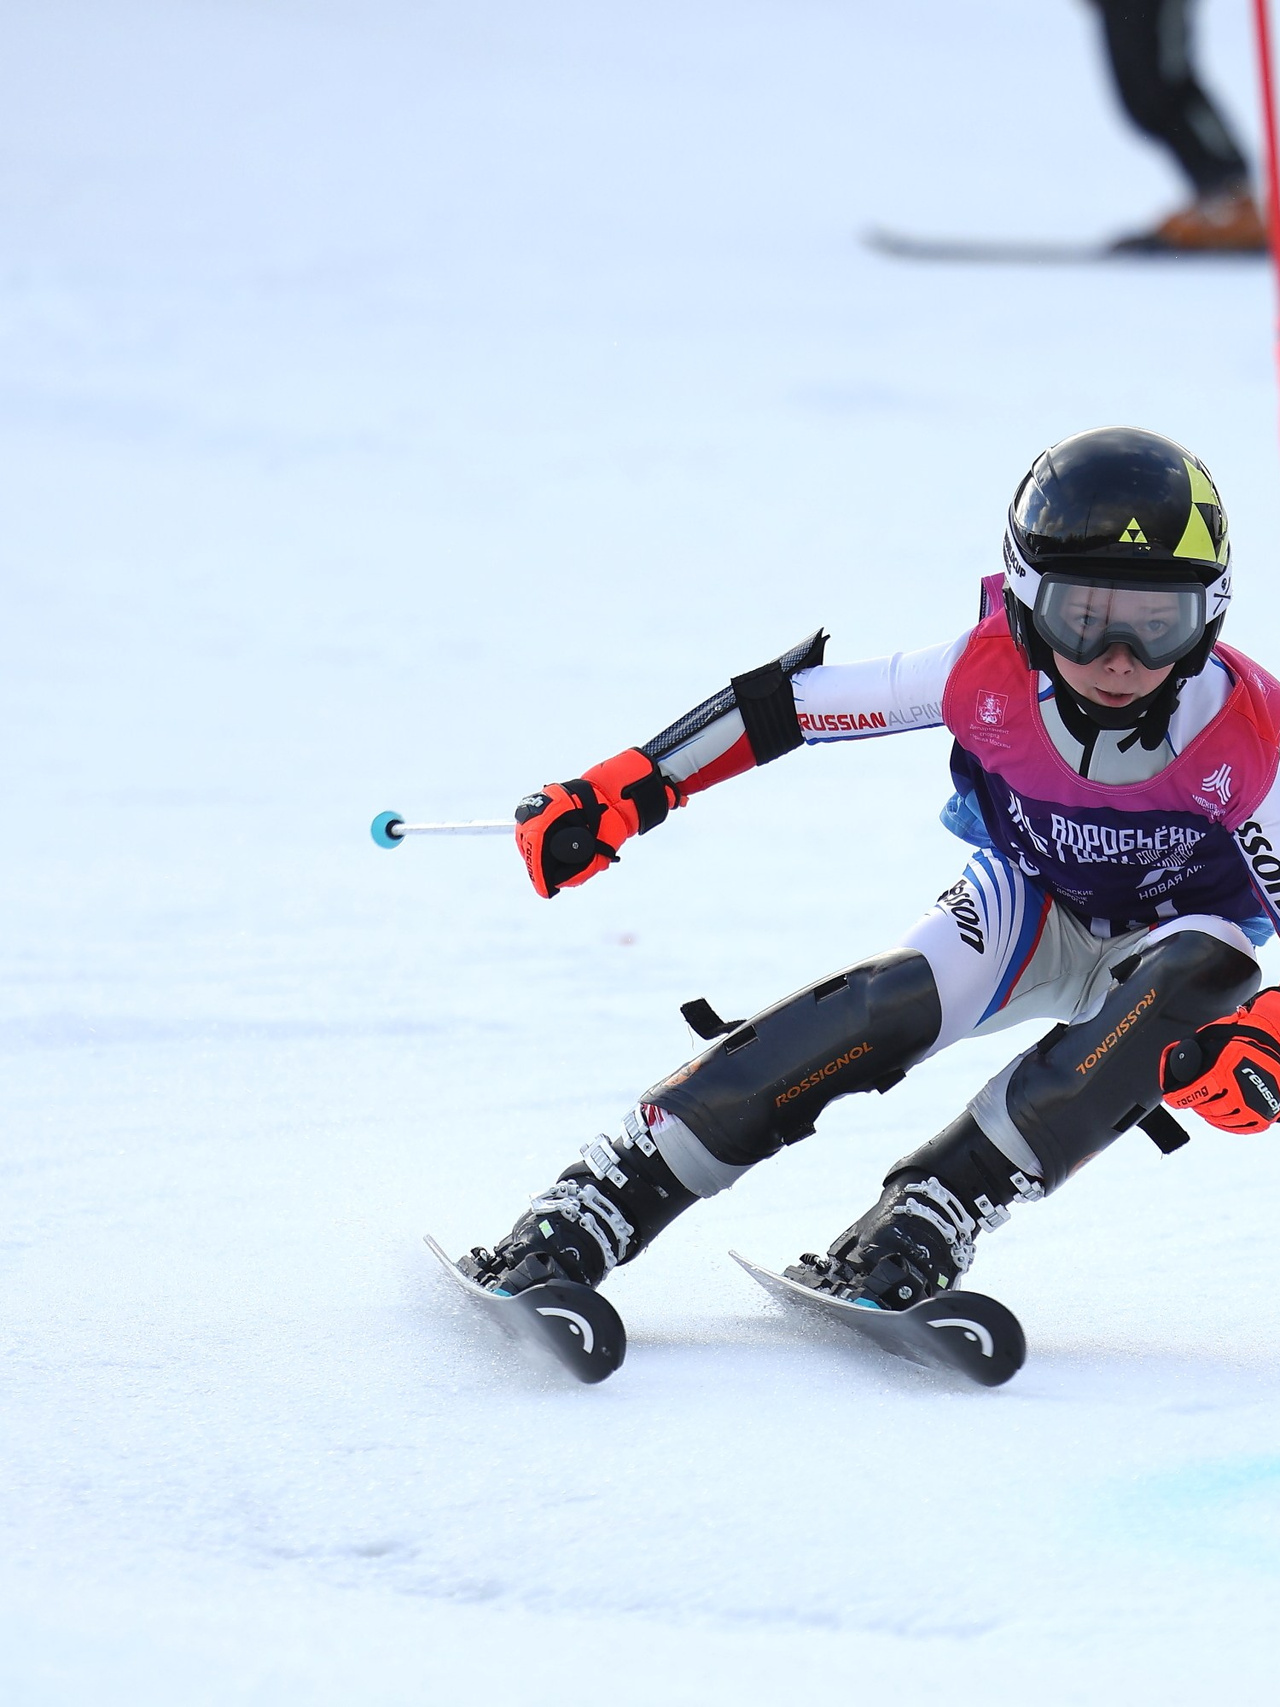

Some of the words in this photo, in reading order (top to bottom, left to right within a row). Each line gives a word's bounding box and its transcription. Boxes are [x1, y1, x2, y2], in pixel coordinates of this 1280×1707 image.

[796, 711, 888, 732] RUSSIAN
[888, 701, 943, 727] ALPIN
[1138, 873, 1183, 900] НОВАЯ
[1075, 988, 1158, 1075] ROSSIGNOL
[775, 1041, 873, 1108] ROSSIGNOL
[1241, 1067, 1280, 1115] reusch
[1176, 1085, 1209, 1107] racing
